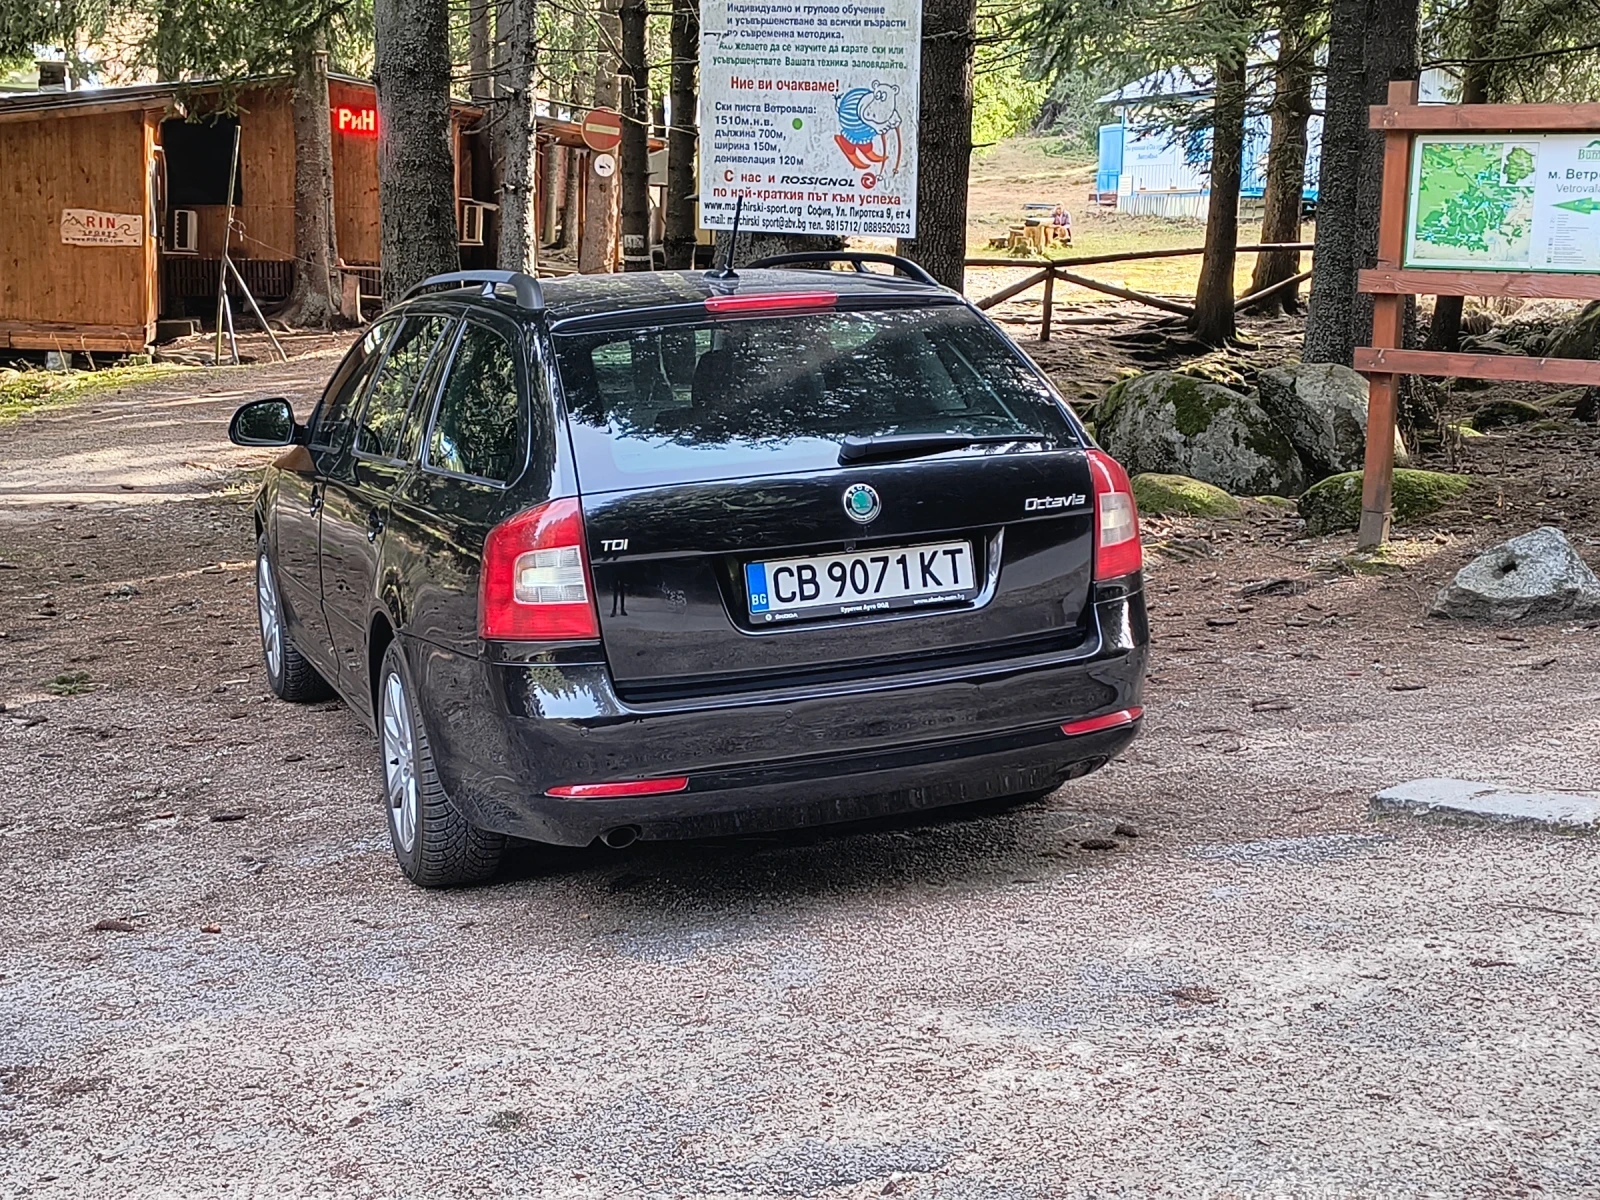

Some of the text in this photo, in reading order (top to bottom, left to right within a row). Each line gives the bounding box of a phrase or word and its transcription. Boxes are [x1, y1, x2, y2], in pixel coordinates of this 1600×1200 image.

[727, 3, 792, 14] Индивидуално
[803, 5, 839, 15] групово
[841, 4, 885, 15] обучение
[735, 18, 814, 27] усъвършенстване
[830, 19, 861, 27] всички
[864, 19, 906, 28] възрасти
[740, 29, 794, 39] съвременна
[797, 31, 844, 40] методика.
[735, 42, 768, 51] желаете
[770, 43, 780, 52] да
[795, 44, 826, 54] научите
[828, 45, 838, 54] да
[841, 45, 868, 54] карате
[871, 46, 886, 54] ски
[888, 46, 904, 54] или
[712, 55, 907, 70] усъвършенствате Вашата техника заповядайте.
[730, 76, 839, 92] Ние ви очакваме!
[715, 101, 817, 115] Ски писта Ветровала:
[715, 116, 773, 126] 1510м.н.в.
[714, 129, 786, 141] дължина 700м,
[714, 142, 781, 153] ширина 150м,
[714, 155, 804, 165] денивелация 120м
[724, 170, 855, 187] С нас и ROSSIGNOL
[1548, 168, 1600, 182] м. Ветр
[713, 188, 727, 197] по
[808, 192, 828, 202] път
[832, 193, 855, 203] към
[858, 194, 901, 206] успеха
[704, 201, 911, 221] www.machirski-sport.org София, Ул. Пиротска 9, ет 4
[86, 215, 116, 229] RIN
[704, 213, 726, 225] e-mail:
[808, 222, 823, 230] тел.
[863, 222, 910, 234] 0889520523
[82, 230, 118, 239] SPORTS
[1024, 493, 1086, 511] Octavia
[600, 538, 628, 552] TDI
[772, 548, 964, 604] CB 9071 KT
[751, 593, 767, 606] BG
